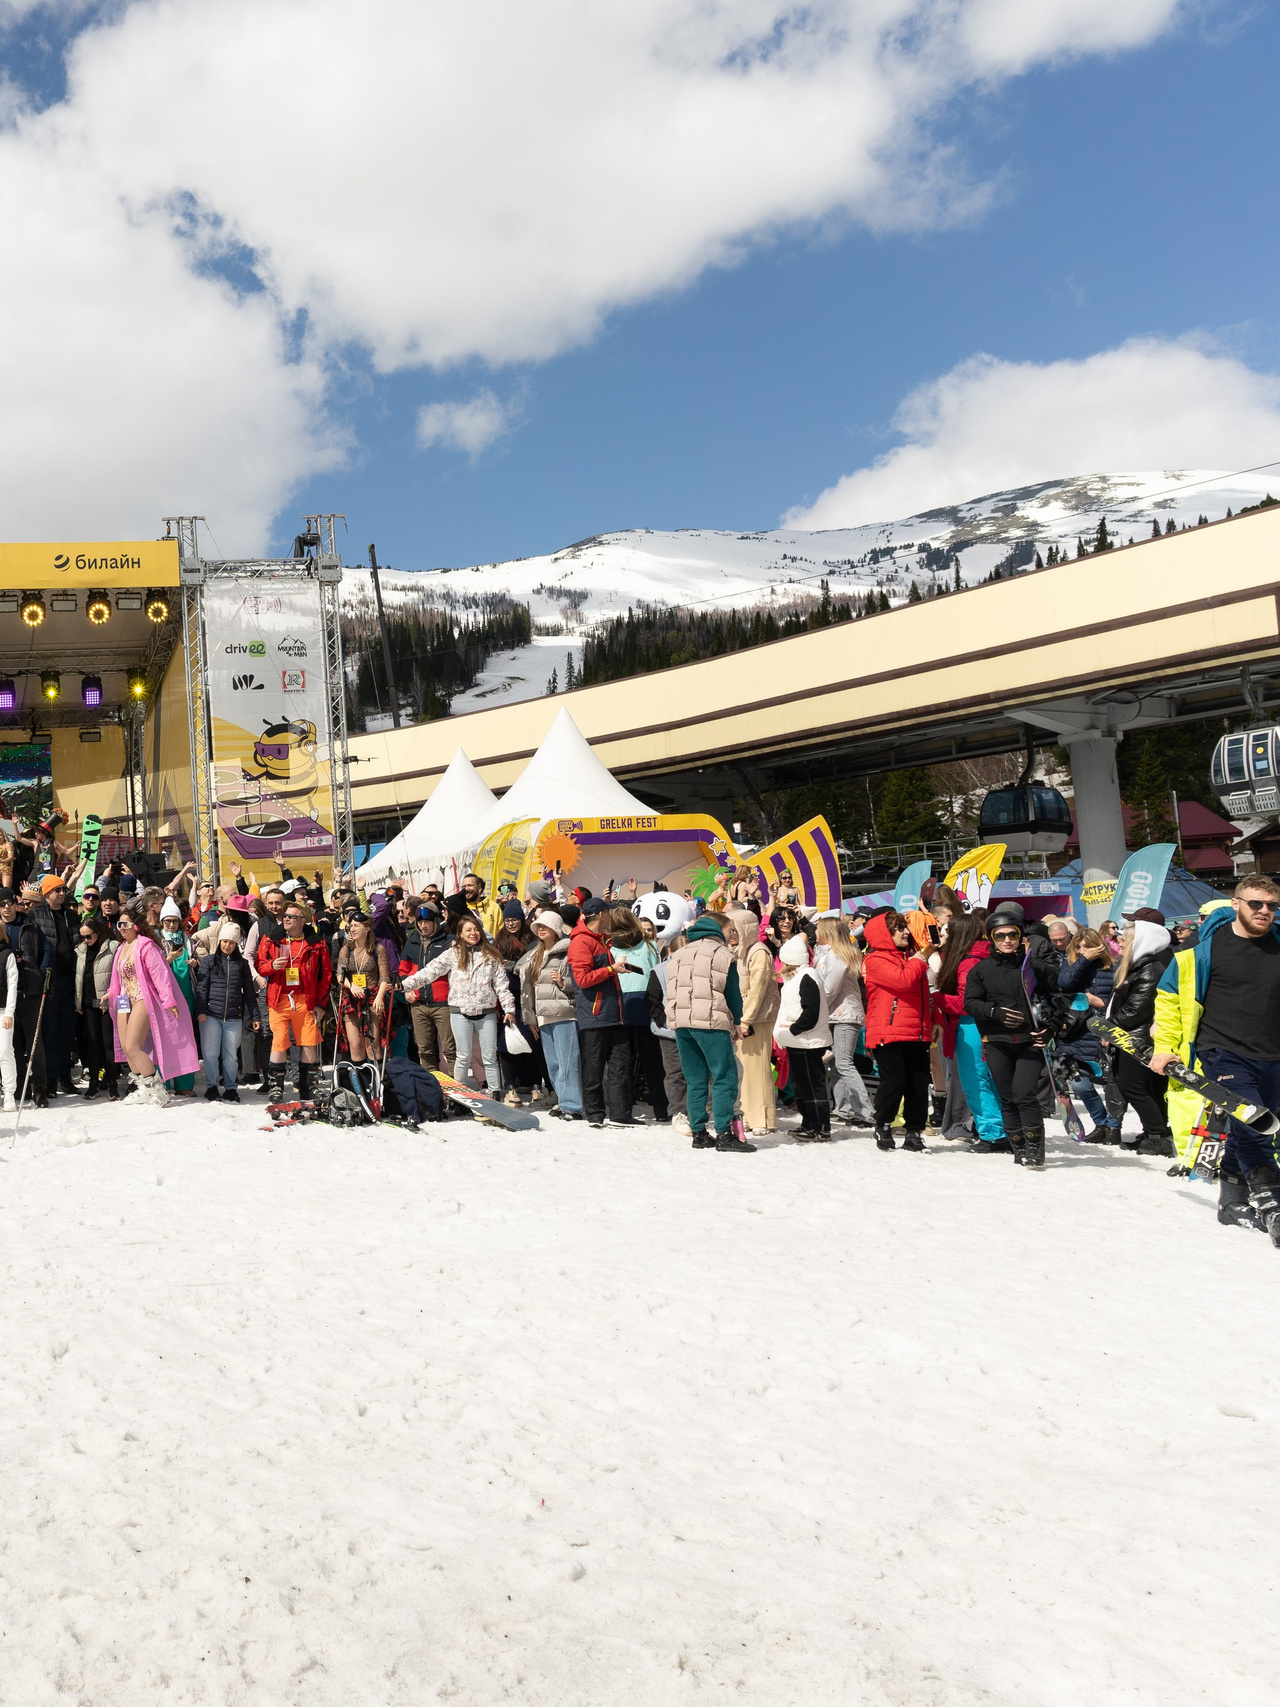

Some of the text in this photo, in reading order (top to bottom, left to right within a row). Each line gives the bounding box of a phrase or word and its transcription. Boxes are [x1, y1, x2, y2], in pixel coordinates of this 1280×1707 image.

[75, 554, 141, 570] билайн
[224, 642, 266, 655] drivee
[3, 753, 42, 763] билайн
[600, 817, 658, 830] GRELKA FEST
[1122, 871, 1153, 914] НФО
